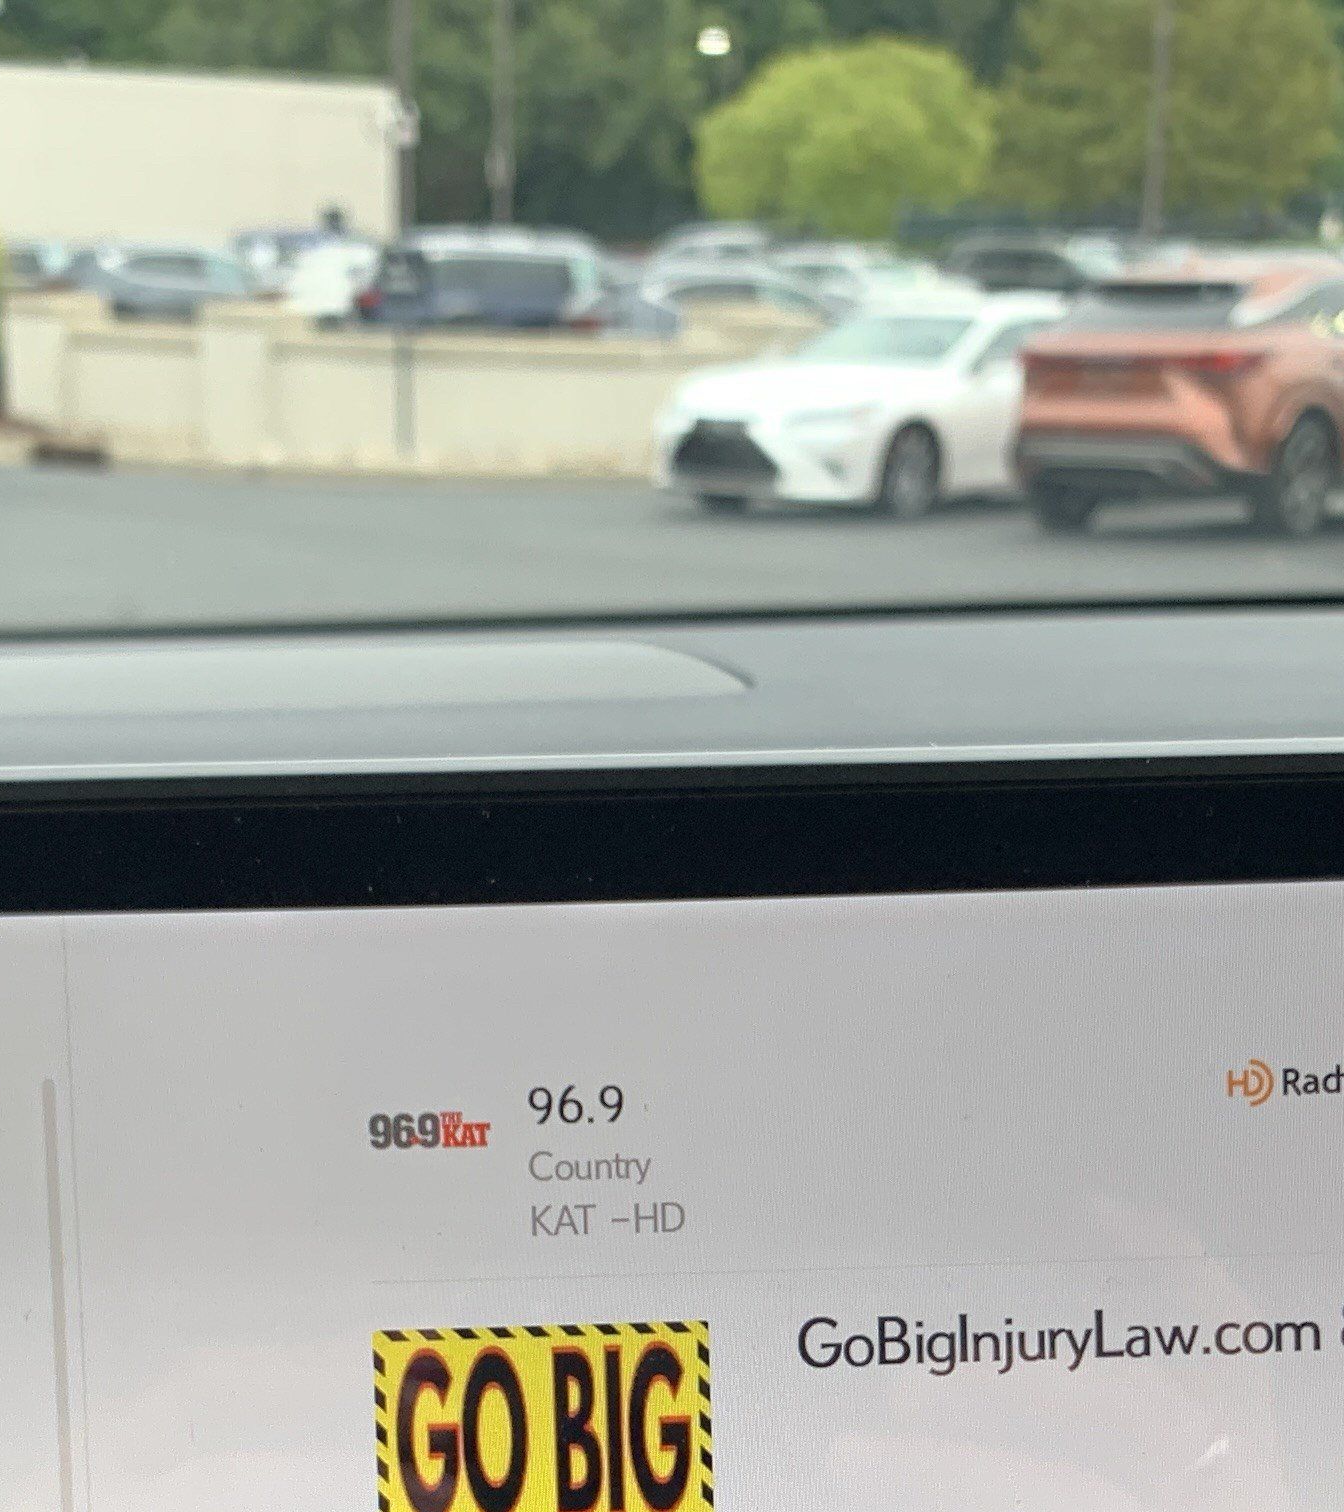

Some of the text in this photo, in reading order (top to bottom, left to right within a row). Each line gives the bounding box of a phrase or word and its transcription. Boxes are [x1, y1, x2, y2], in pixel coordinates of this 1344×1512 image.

[529, 1084, 624, 1125] 96.9
[442, 1122, 491, 1148] KAT
[529, 1150, 651, 1184] Country
[531, 1203, 596, 1236] KAT
[798, 1309, 1321, 1375] GoBigInjuryLaw.com
